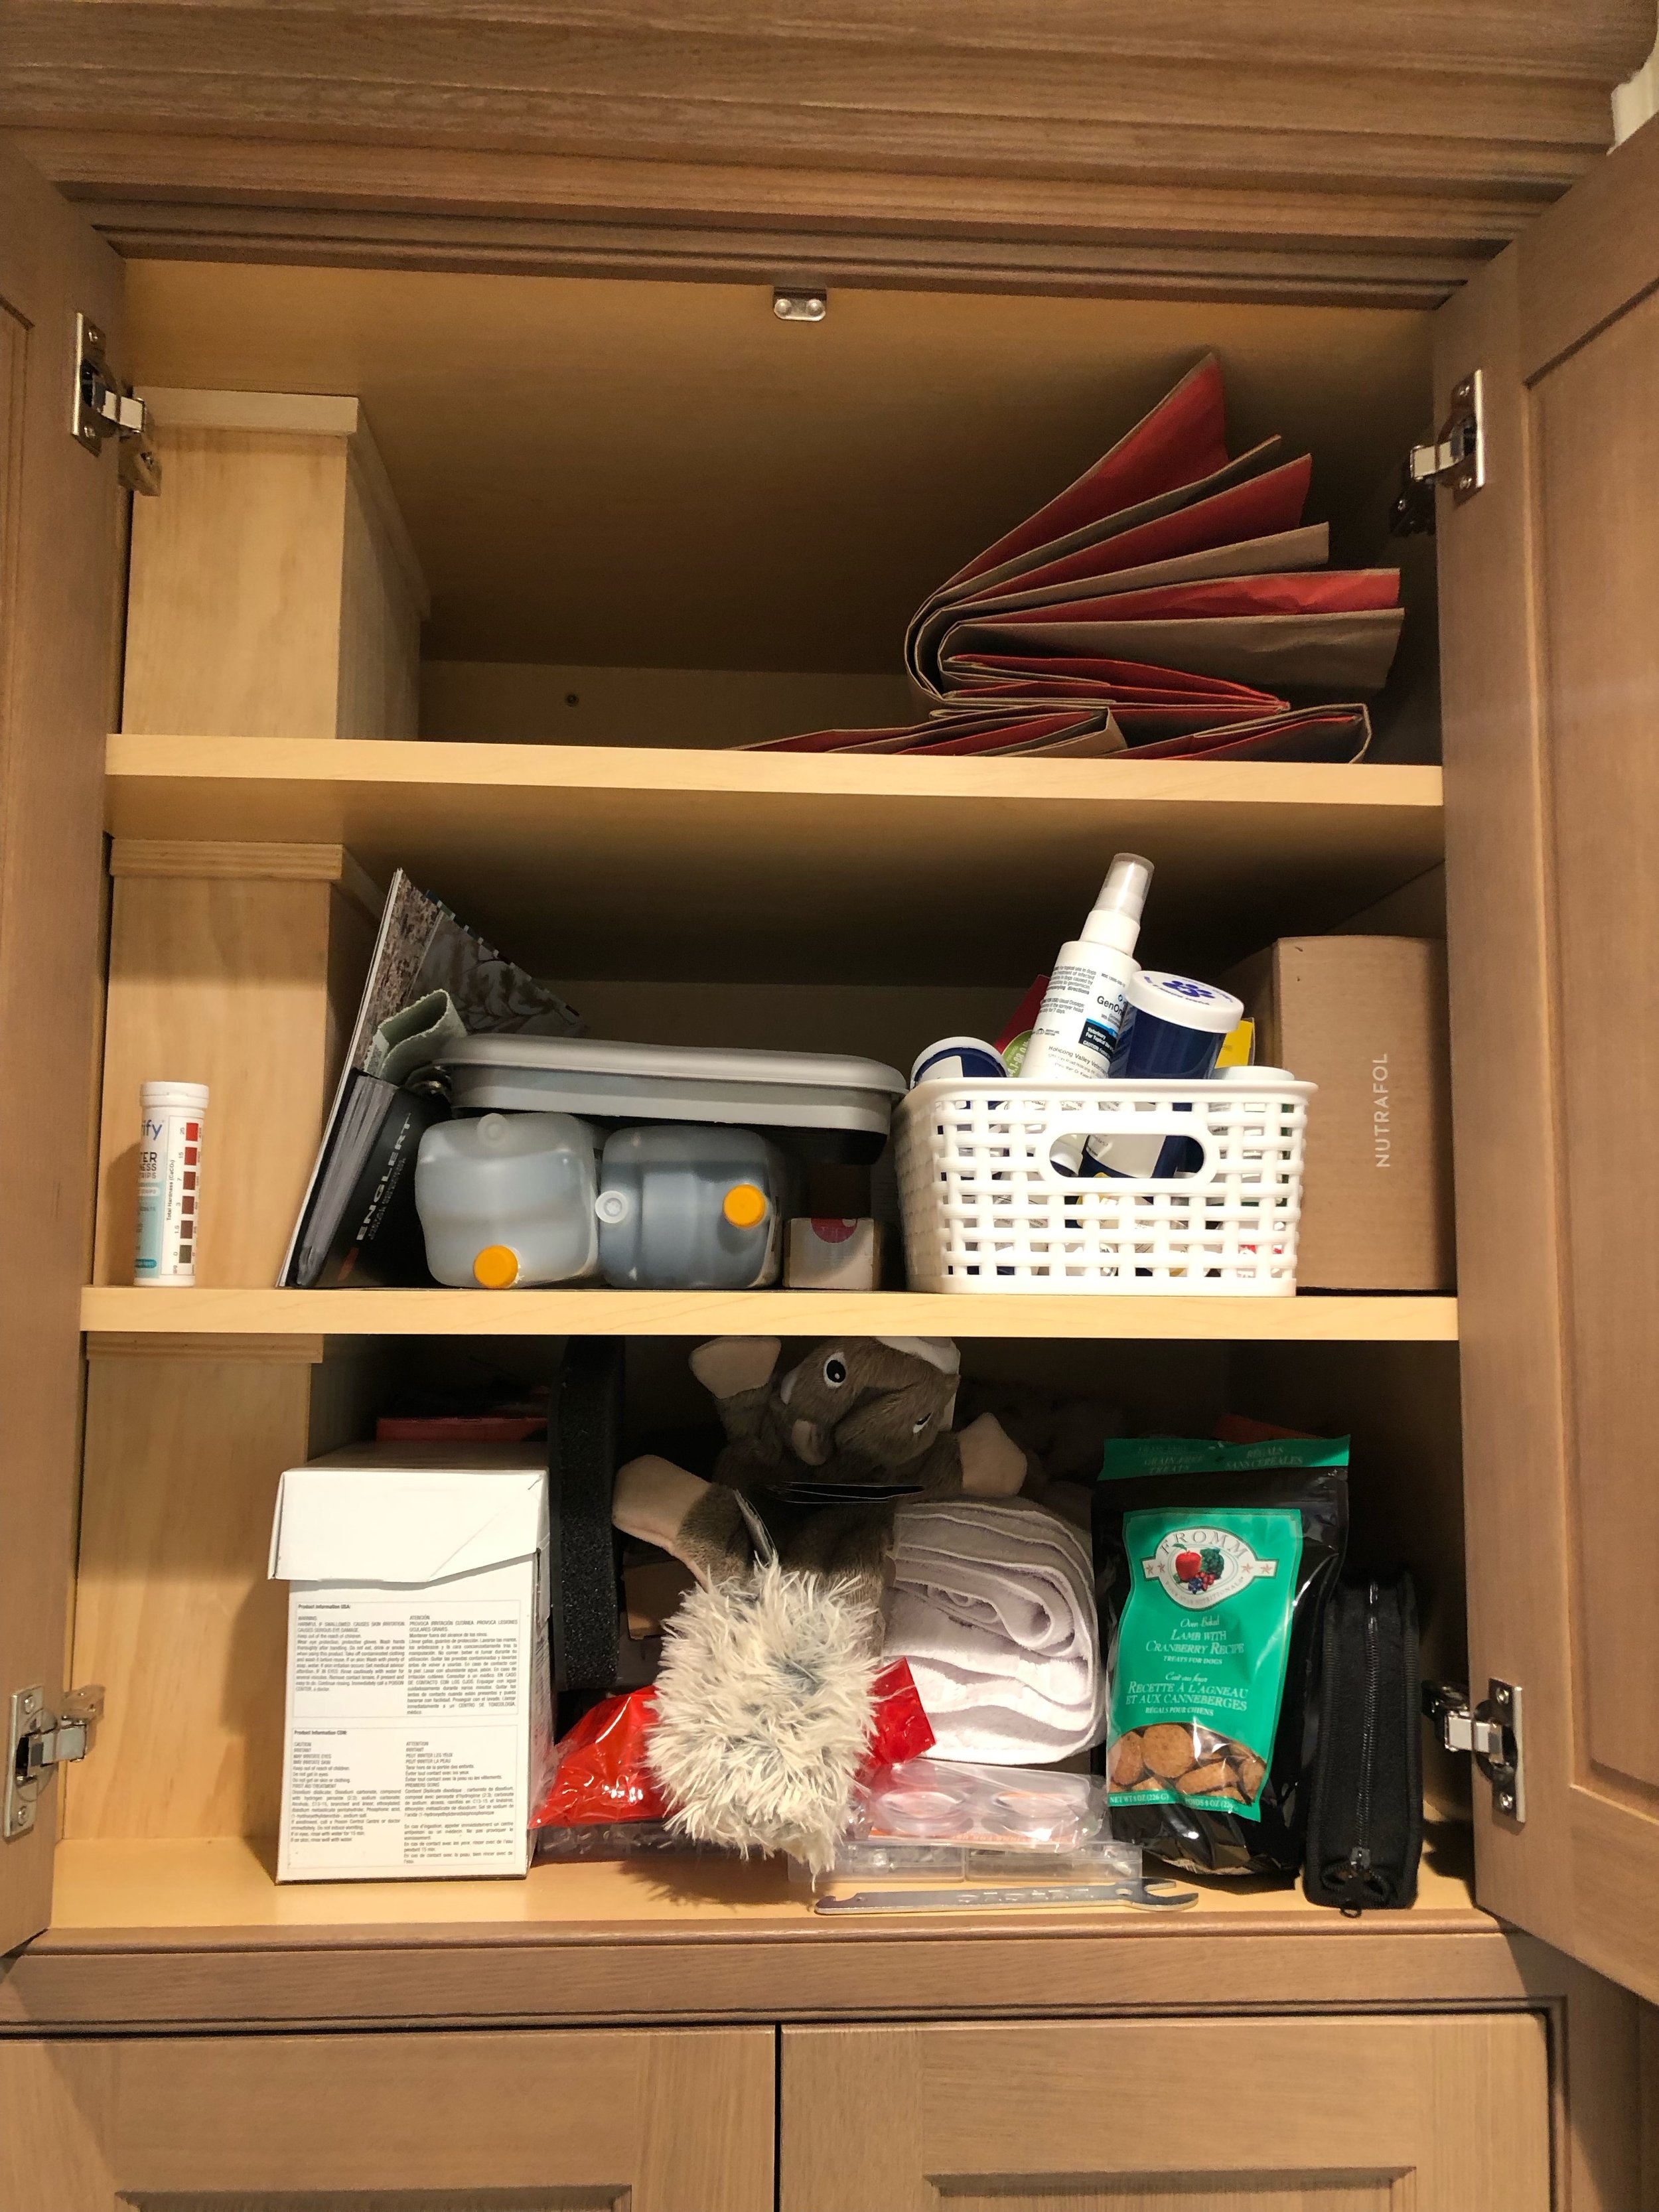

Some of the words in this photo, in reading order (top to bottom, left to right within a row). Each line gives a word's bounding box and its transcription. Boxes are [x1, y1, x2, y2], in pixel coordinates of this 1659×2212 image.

[1067, 986, 1090, 995] directions
[1088, 1027, 1106, 1040] Veterinary
[1093, 1035, 1106, 1045] Topical
[1048, 1046, 1074, 1057] Holicong
[1075, 1053, 1091, 1065] Valley
[1372, 1053, 1391, 1167] NUTRAFOL
[356, 1112, 411, 1240] ENGLERT
[1161, 1530, 1248, 1559] FROMM
[1163, 1655, 1187, 1664] TREATS
[1128, 1680, 1175, 1694] RECETTE
[1125, 1694, 1137, 1705] ET
[1139, 1694, 1162, 1704] AUX
[1163, 1694, 1248, 1711] CANNEBERGES
[1145, 1706, 1169, 1714] RÉGALS
[1187, 1707, 1214, 1716] CHIENS
